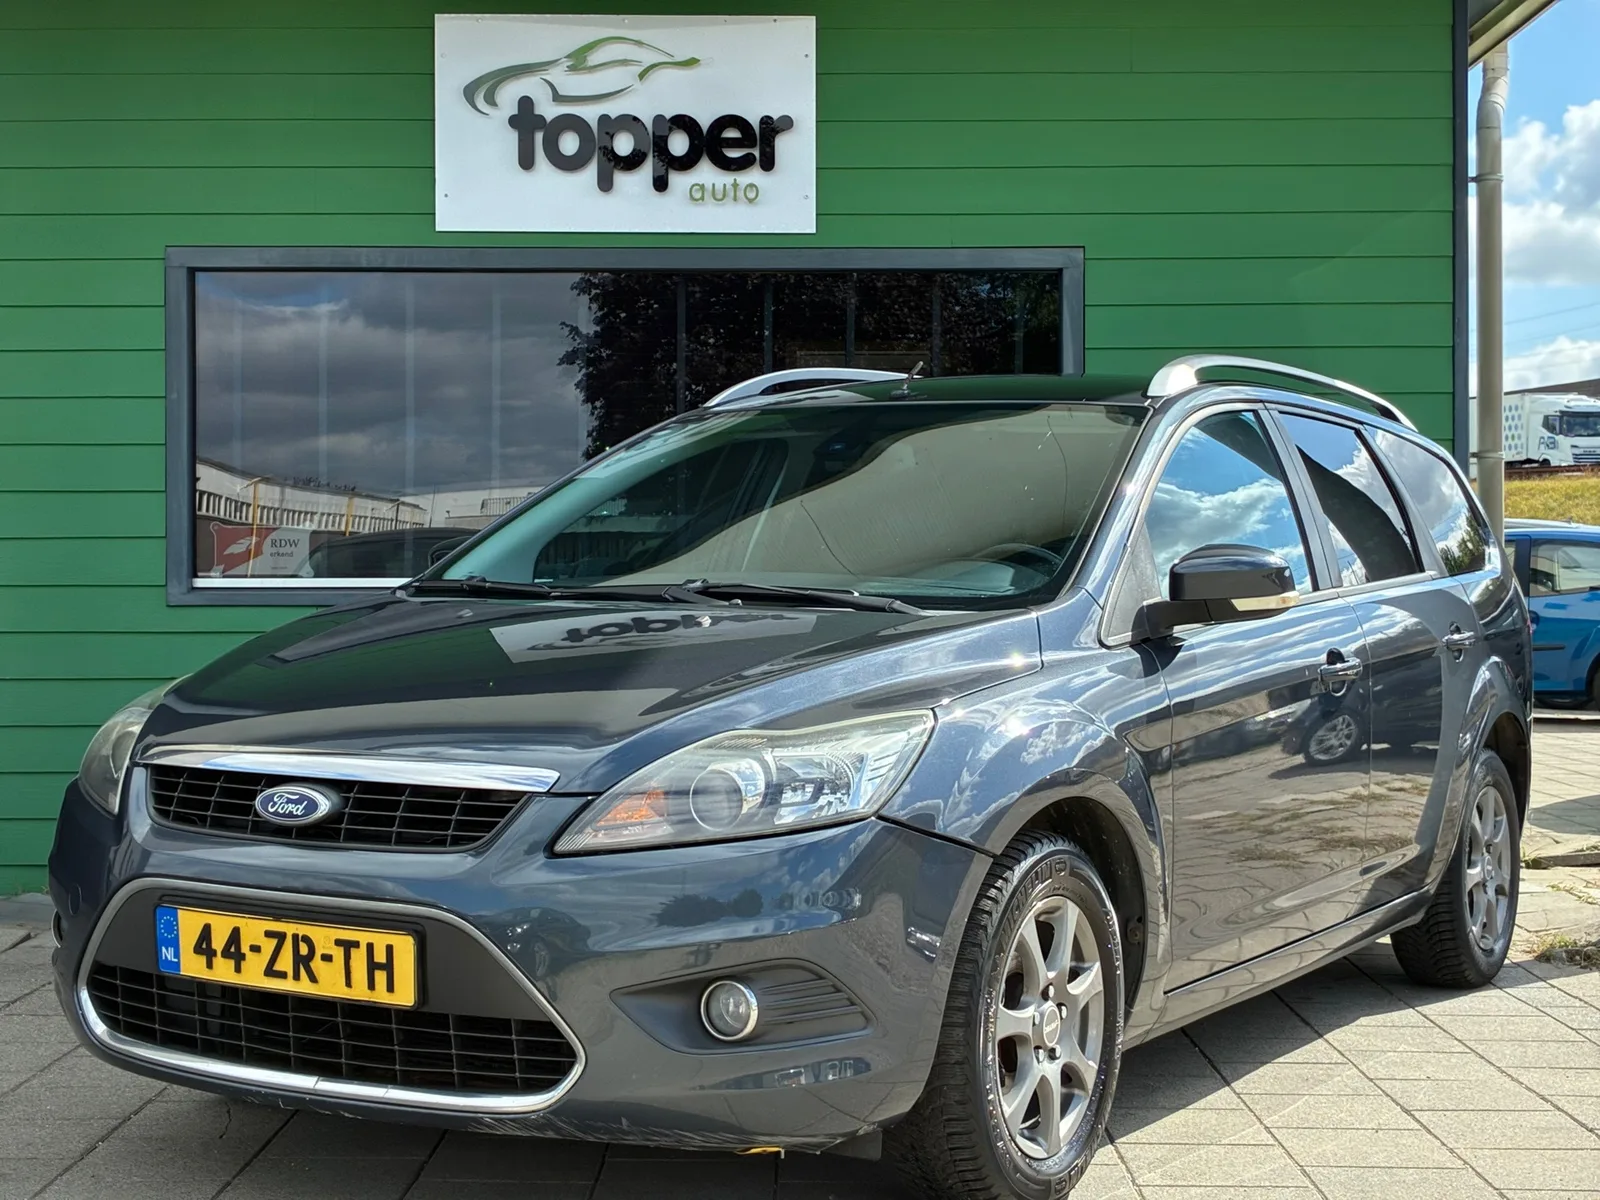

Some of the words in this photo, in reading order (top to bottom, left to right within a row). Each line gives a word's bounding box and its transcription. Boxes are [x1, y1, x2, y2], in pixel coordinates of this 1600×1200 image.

[507, 95, 794, 193] topper
[688, 178, 760, 203] auto
[269, 550, 293, 558] erkend
[270, 538, 300, 548] RDW
[268, 792, 308, 817] Ford
[162, 946, 178, 962] NL
[193, 923, 395, 994] 44-ZR-TH
